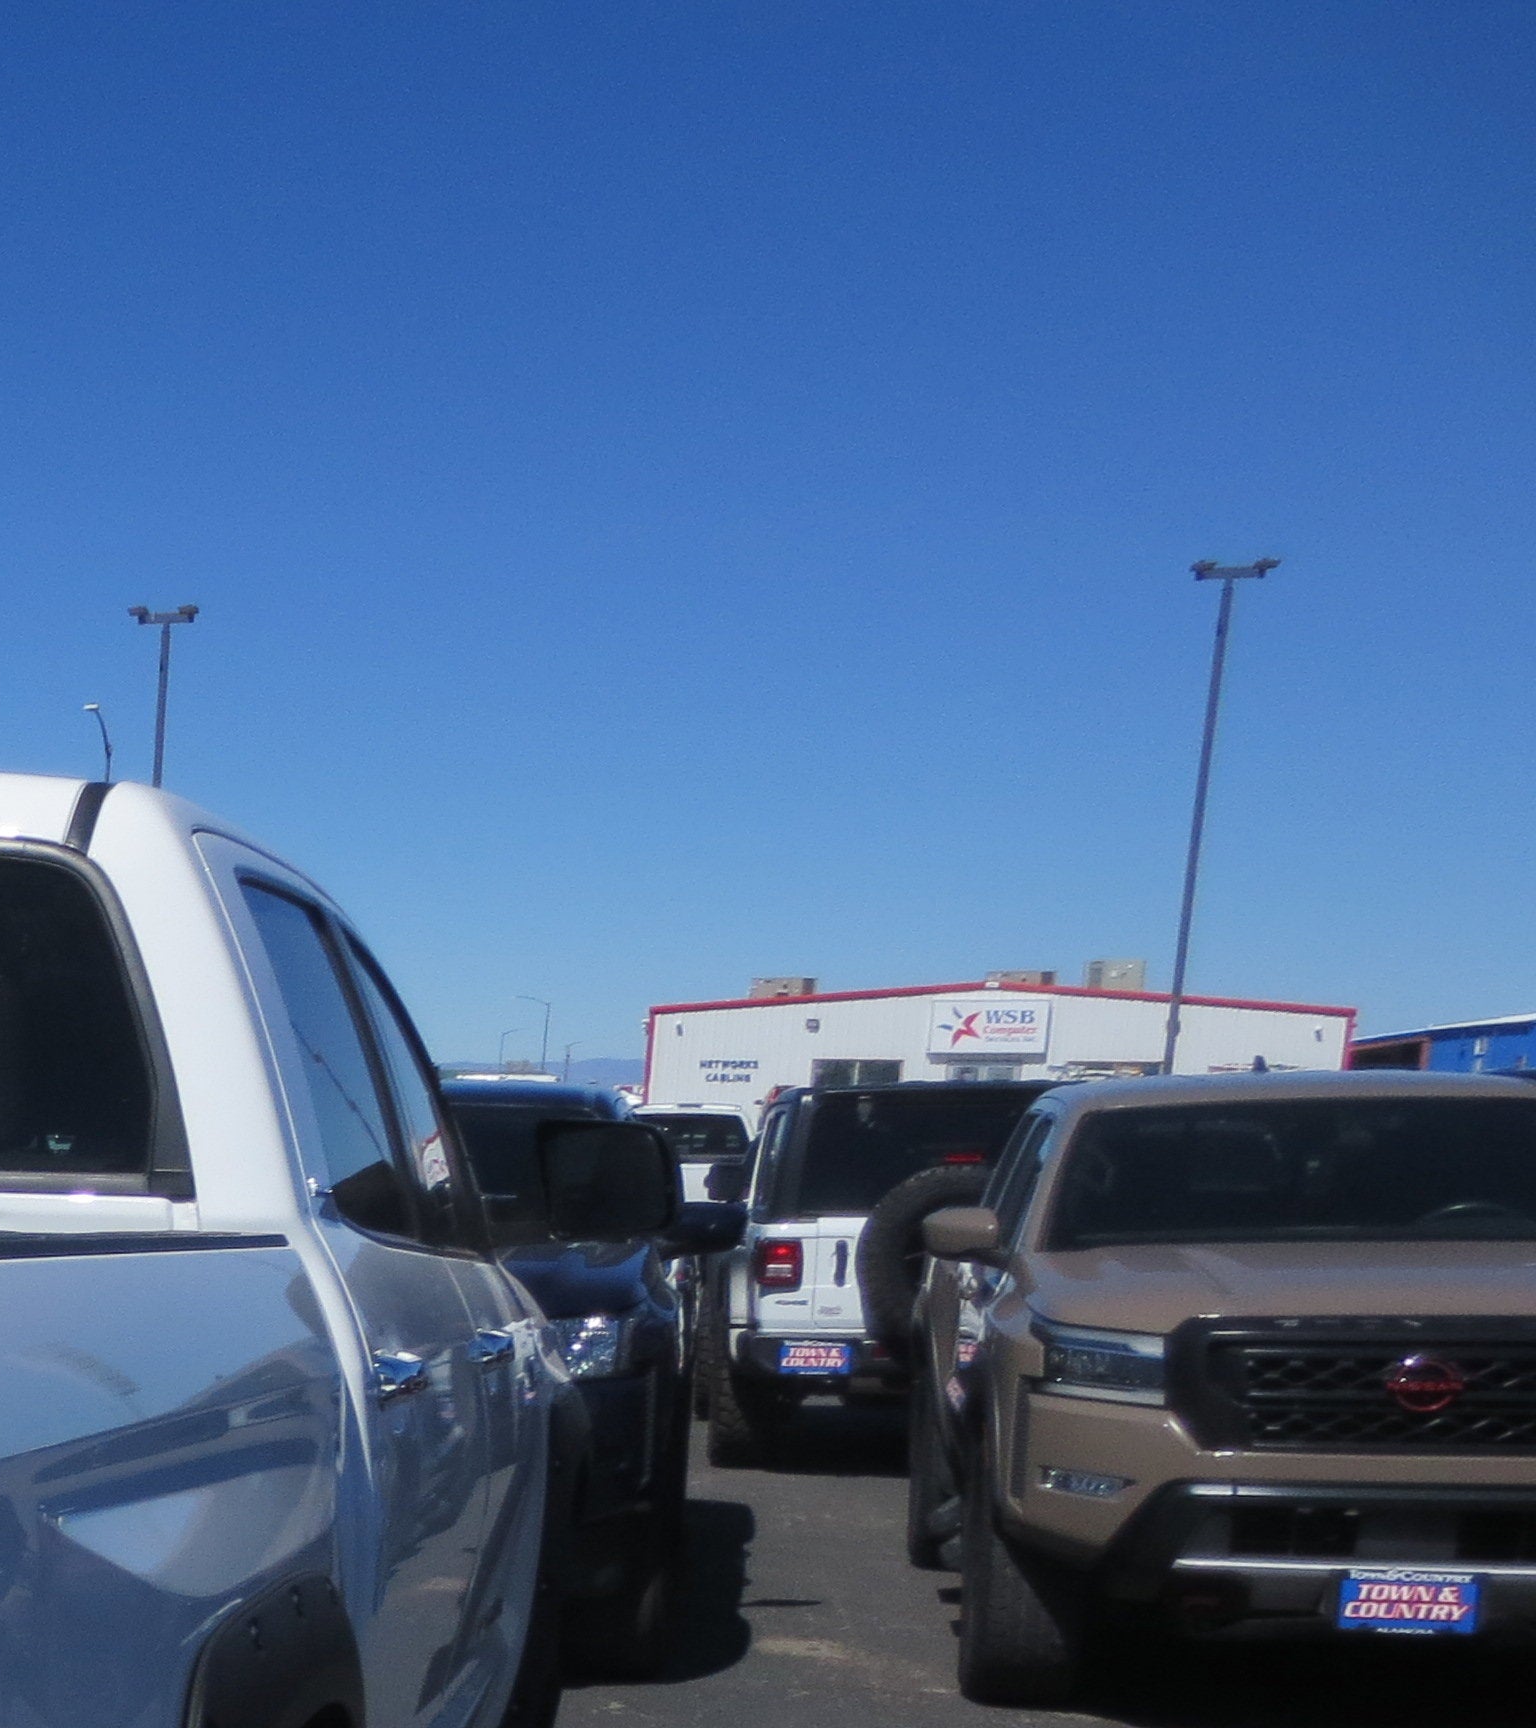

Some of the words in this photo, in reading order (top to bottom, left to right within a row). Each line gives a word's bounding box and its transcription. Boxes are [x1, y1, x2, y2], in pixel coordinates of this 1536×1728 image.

[985, 1009, 1035, 1024] WSB
[789, 1347, 827, 1357] TOWN
[781, 1357, 846, 1368] COUNTRY
[1357, 1583, 1436, 1602] TOWN
[1437, 1585, 1460, 1602] &
[1344, 1601, 1470, 1622] COUNTRY
